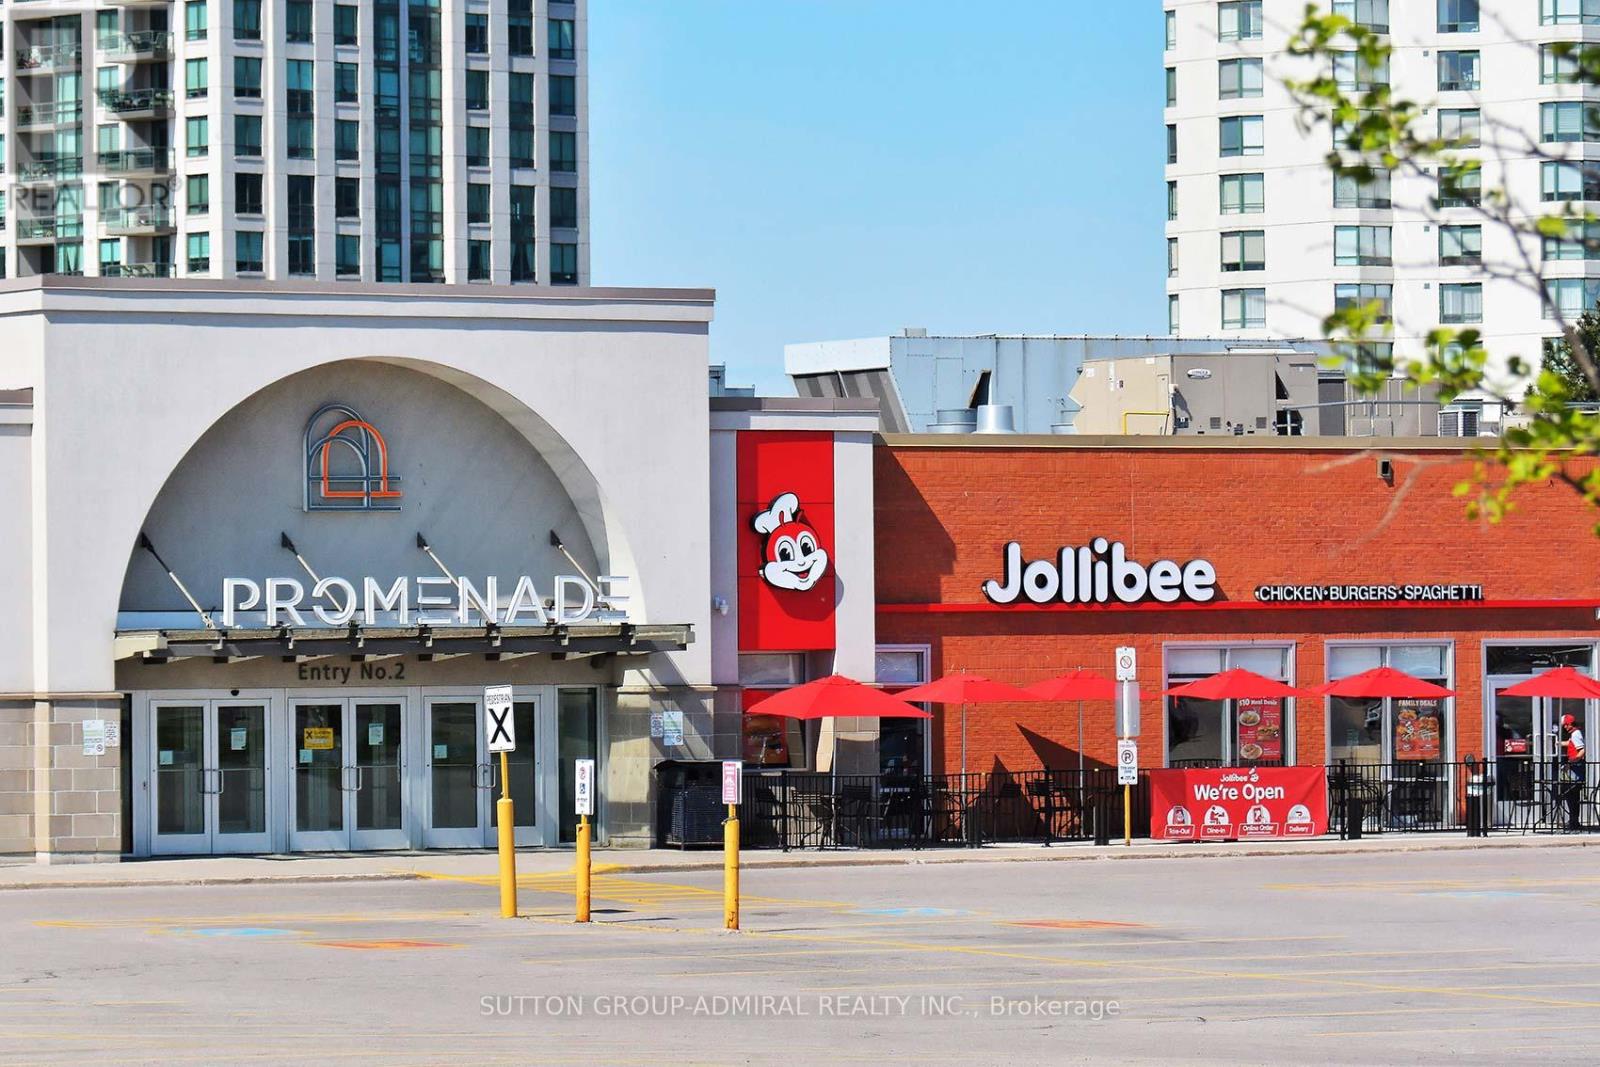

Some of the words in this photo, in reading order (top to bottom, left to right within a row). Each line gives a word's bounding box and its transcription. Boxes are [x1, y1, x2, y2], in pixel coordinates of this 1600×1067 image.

[982, 537, 1217, 605] Jollibee
[221, 575, 631, 625] PROMENADE
[298, 663, 350, 684] Entry
[360, 663, 405, 680] No.2
[1220, 774, 1248, 782] Jollibee
[1242, 785, 1285, 803] Open
